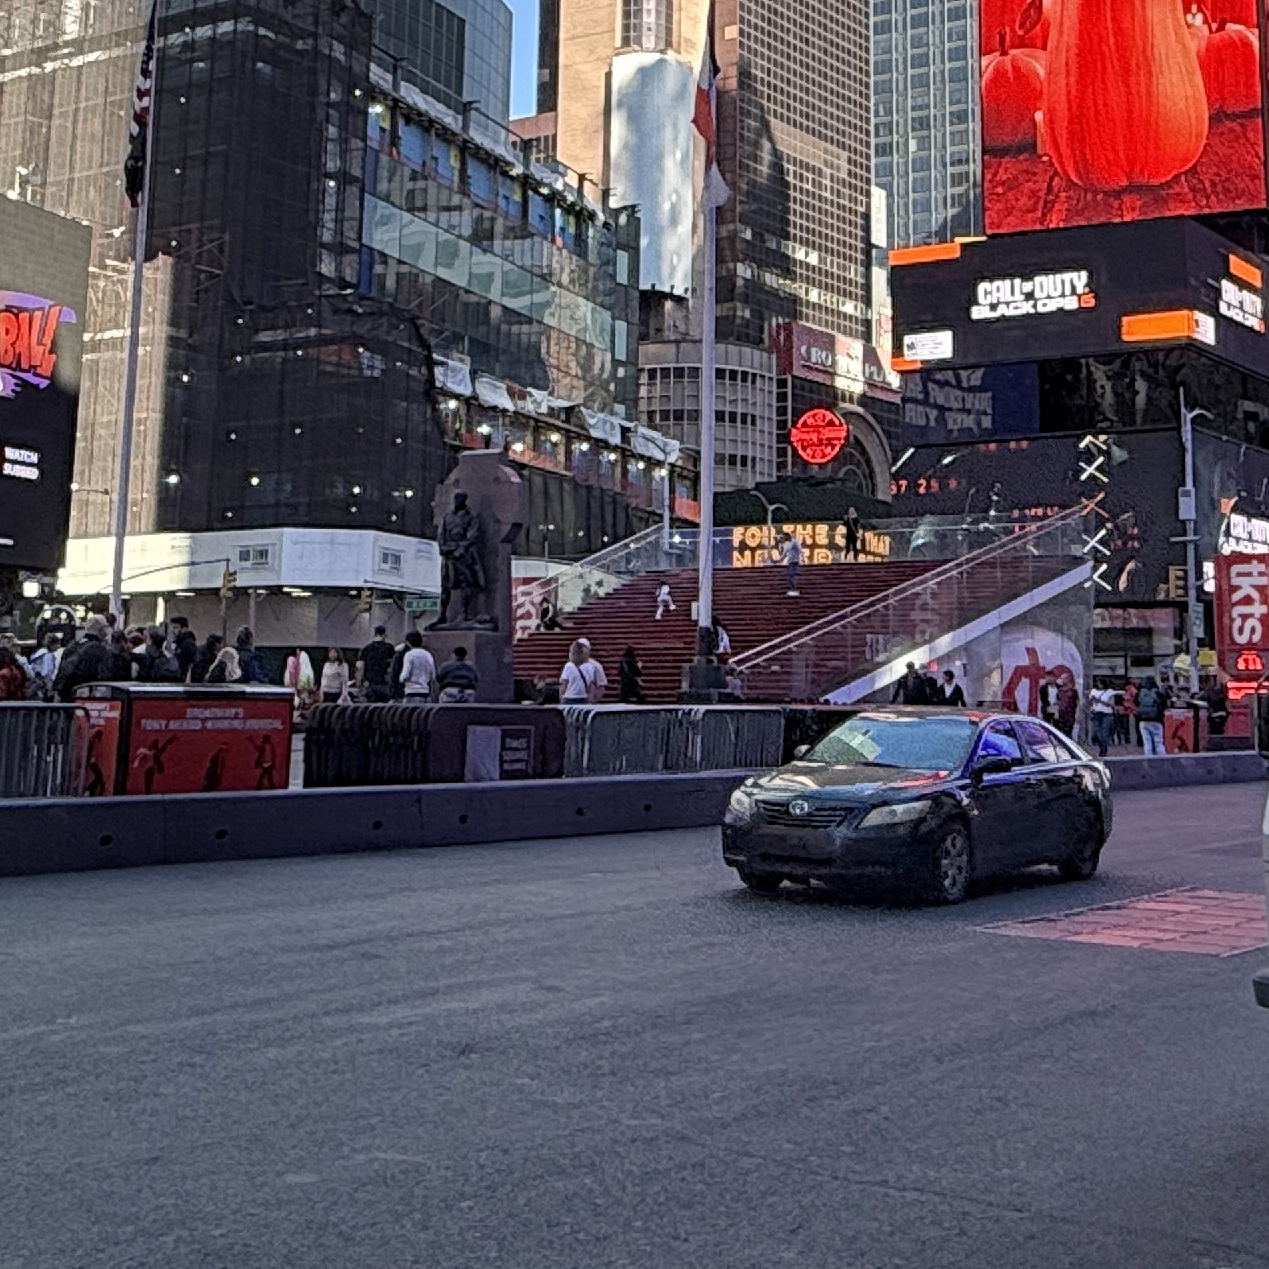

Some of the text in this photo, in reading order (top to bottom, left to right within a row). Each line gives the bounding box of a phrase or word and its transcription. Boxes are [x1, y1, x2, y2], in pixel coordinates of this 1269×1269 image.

[978, 278, 1023, 304] CALL
[1033, 270, 1089, 299] DUTY
[970, 293, 1096, 320] BLACK OPS 6
